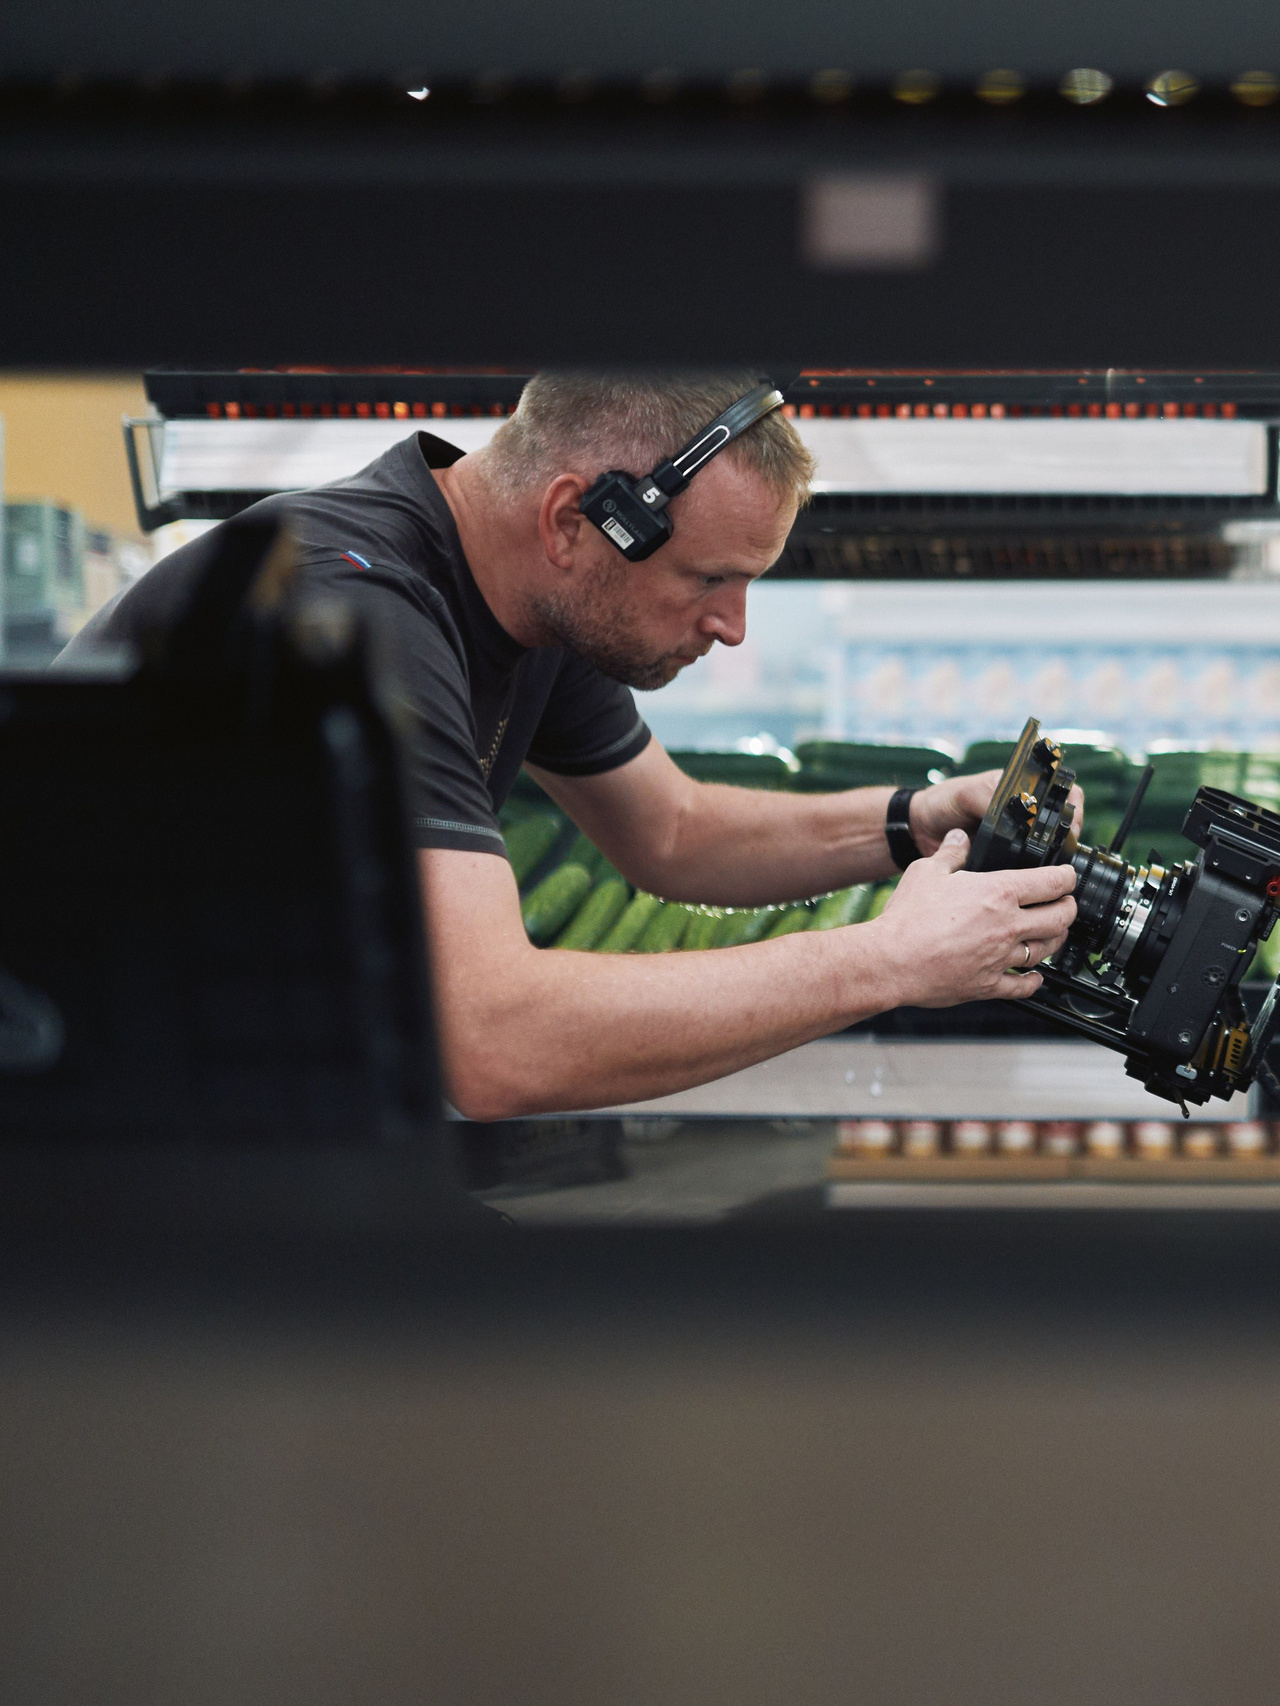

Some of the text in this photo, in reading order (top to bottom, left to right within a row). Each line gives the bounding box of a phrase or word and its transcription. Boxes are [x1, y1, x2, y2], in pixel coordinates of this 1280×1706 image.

[642, 487, 661, 504] 5
[615, 510, 647, 543] HOLLYLAND
[1220, 942, 1237, 951] POWER
